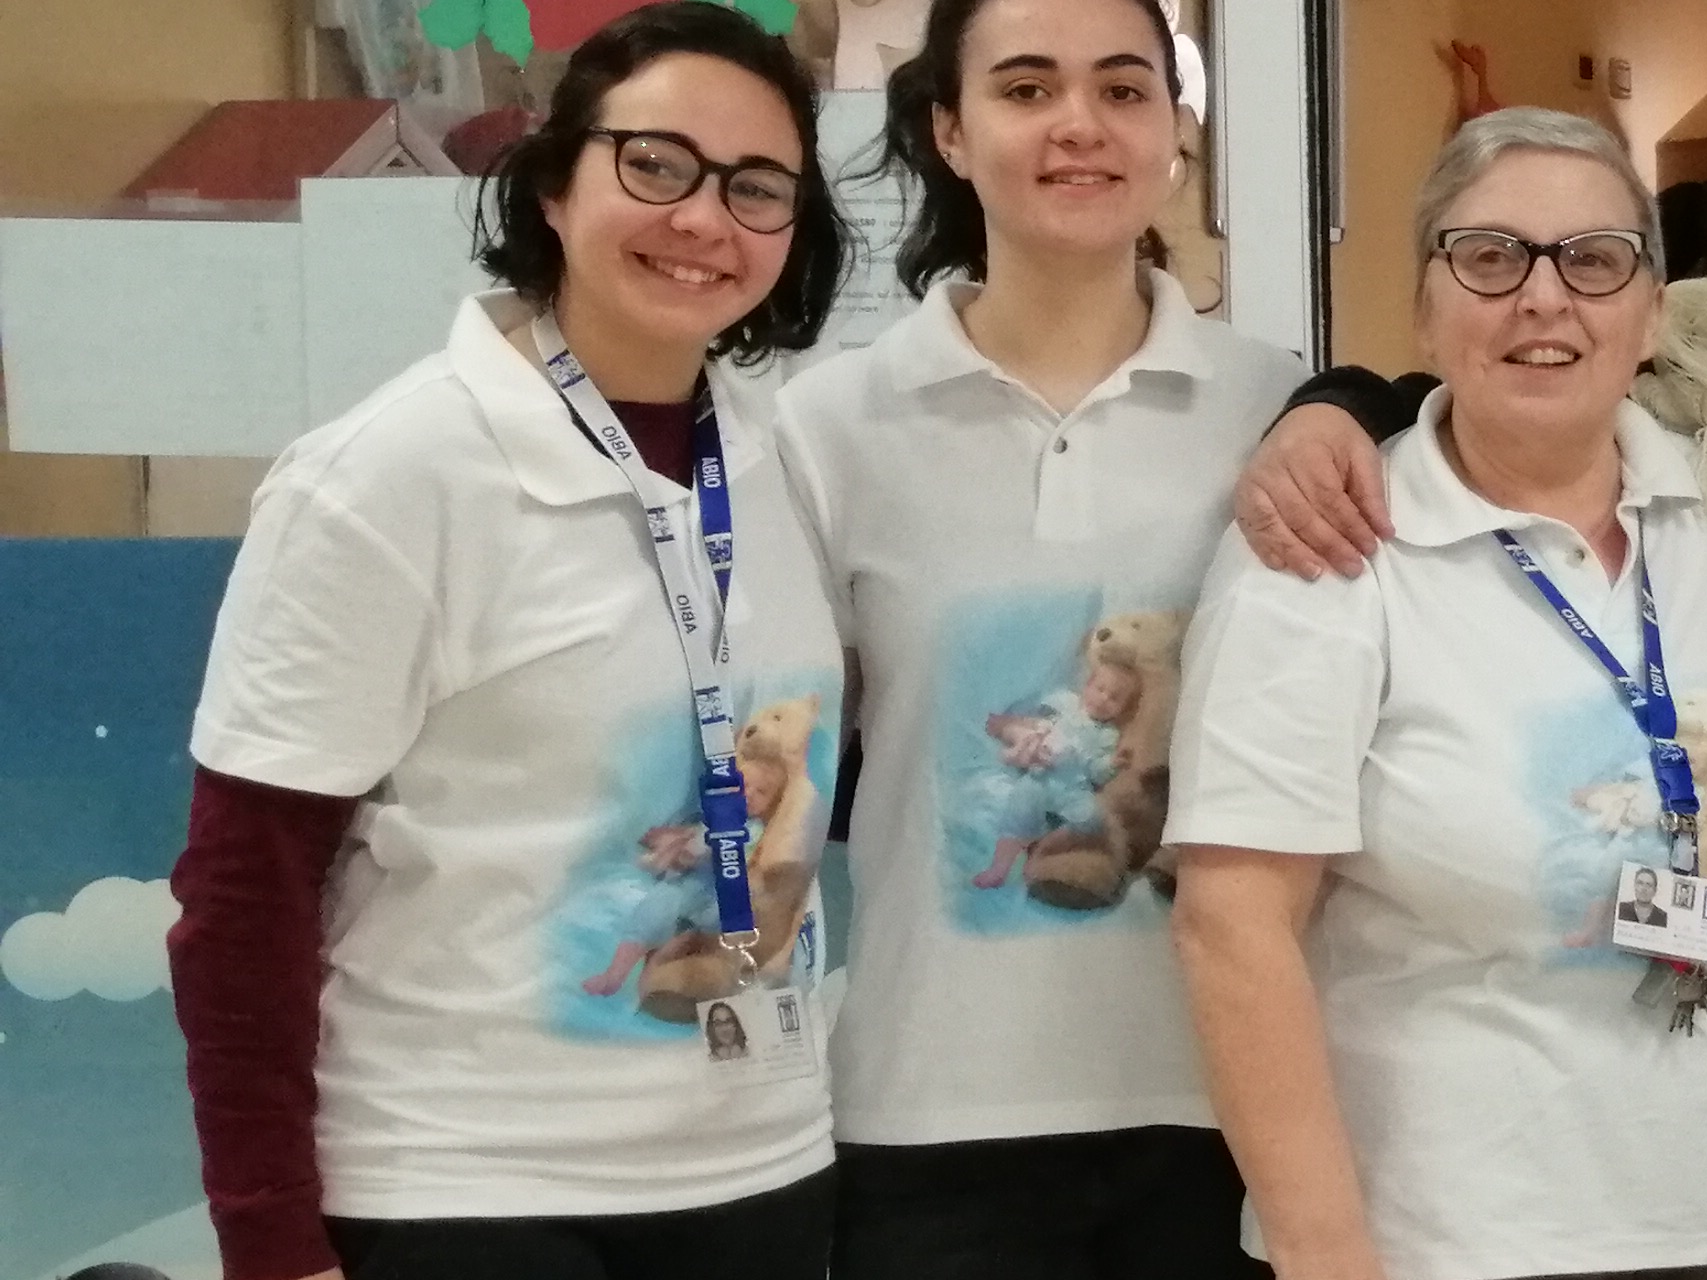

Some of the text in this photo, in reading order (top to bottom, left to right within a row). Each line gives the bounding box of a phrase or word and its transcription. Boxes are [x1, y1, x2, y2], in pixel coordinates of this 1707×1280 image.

[701, 456, 721, 488] ABIO
[1561, 608, 1593, 639] ABIO
[1650, 662, 1667, 697] ABIO
[719, 839, 740, 879] ABIO
